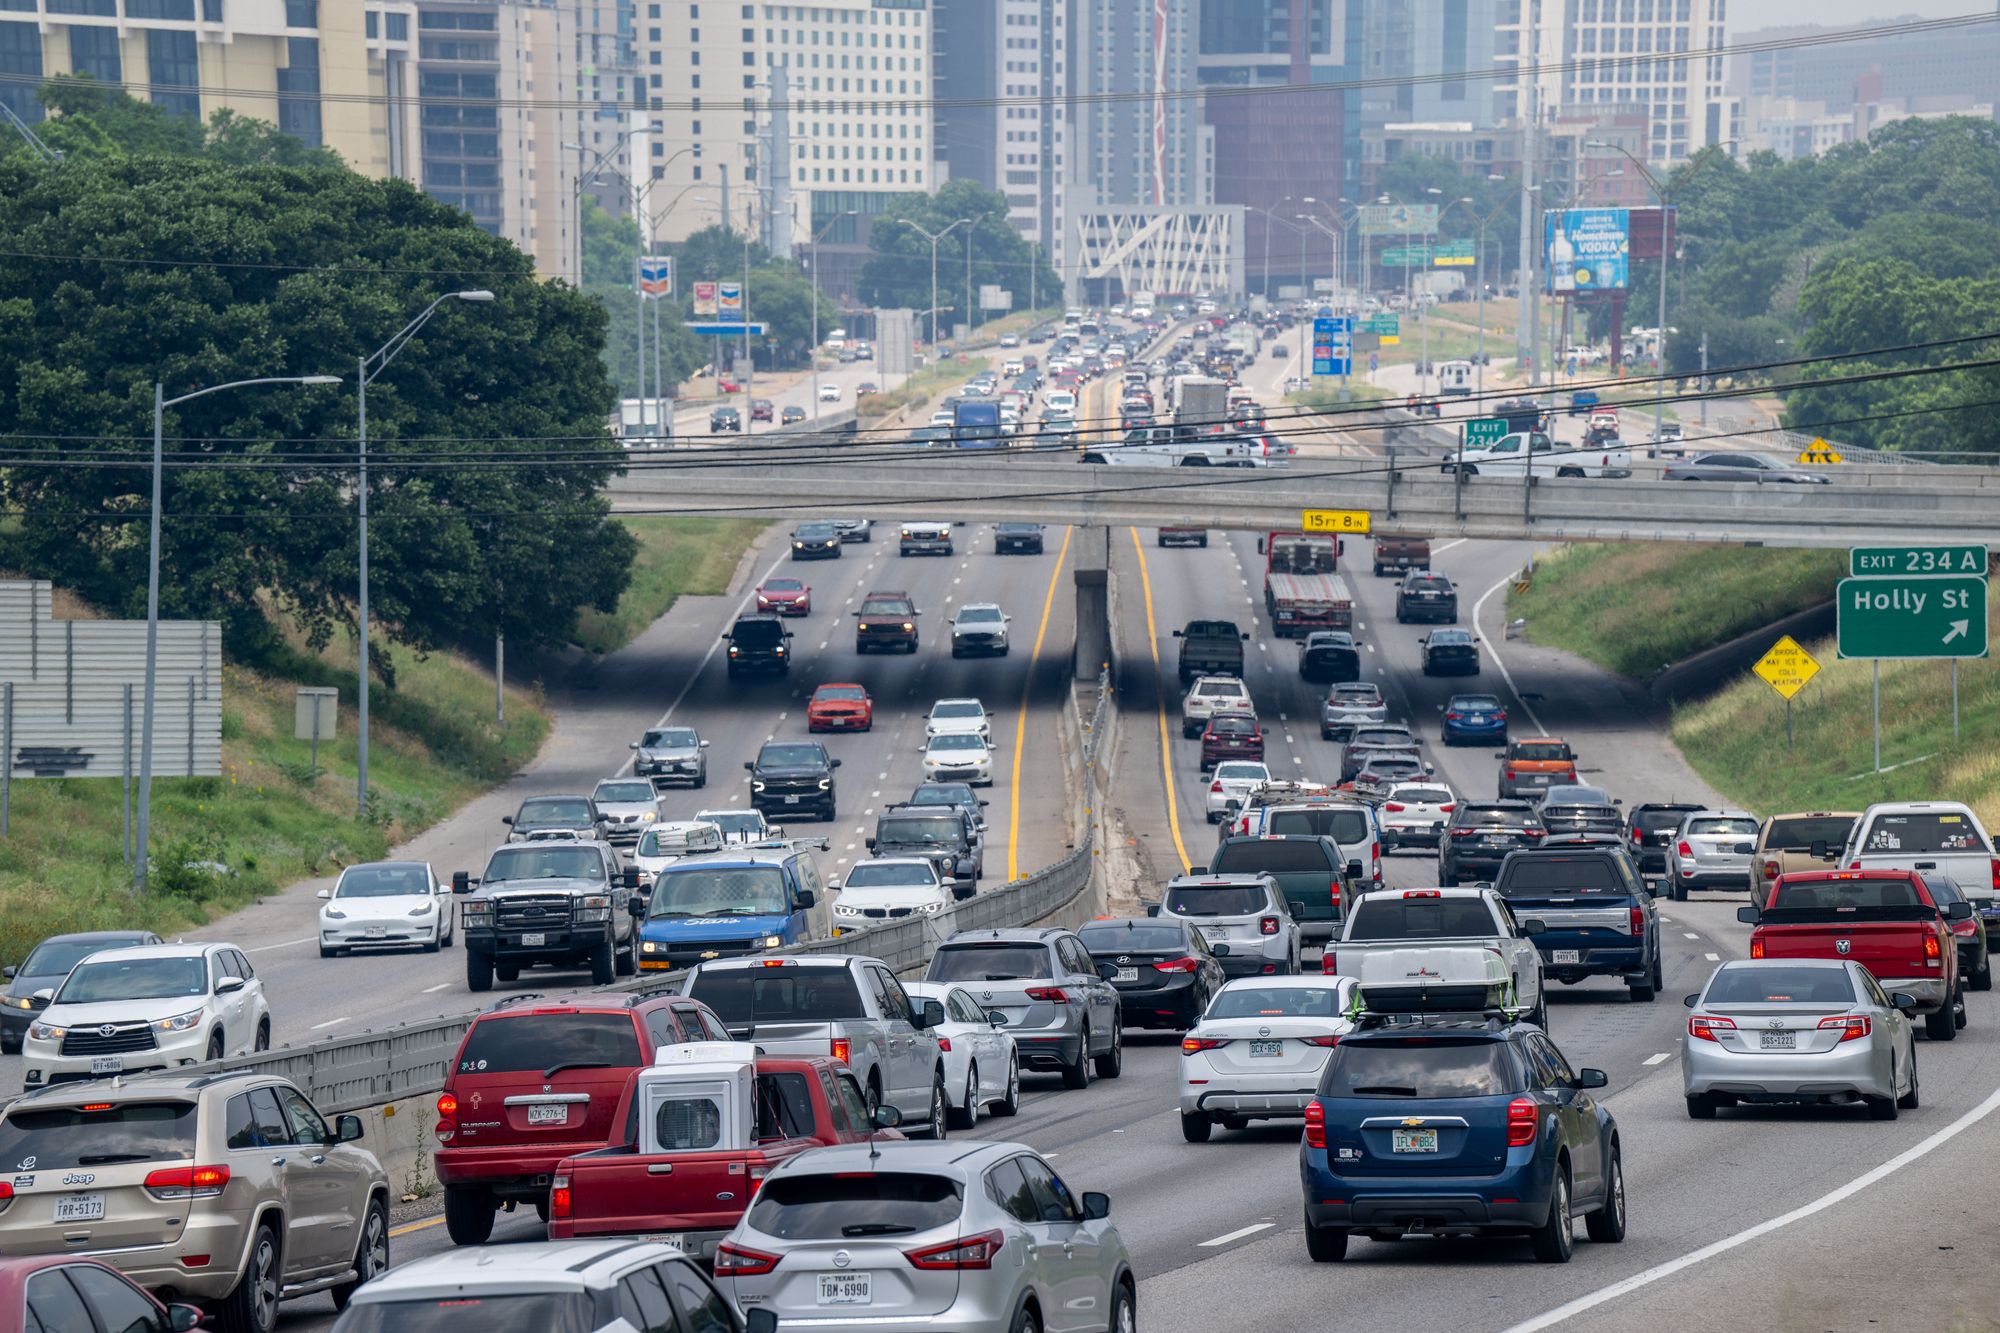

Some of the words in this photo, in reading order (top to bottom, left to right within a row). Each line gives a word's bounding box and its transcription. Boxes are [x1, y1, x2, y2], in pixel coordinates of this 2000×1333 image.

[1572, 230, 1625, 241] Hometown
[1579, 241, 1617, 253] VODKA
[1473, 423, 1500, 432] EXIT
[1310, 515, 1324, 526] 15
[1343, 515, 1352, 527] 8
[1860, 555, 1896, 569] EXIT
[1906, 551, 1952, 571] 234
[1960, 551, 1977, 570] A
[1854, 588, 1927, 614] Holly
[1942, 589, 1969, 609] St
[1772, 678, 1803, 686] WEATHER
[63, 1173, 95, 1185] Jeep
